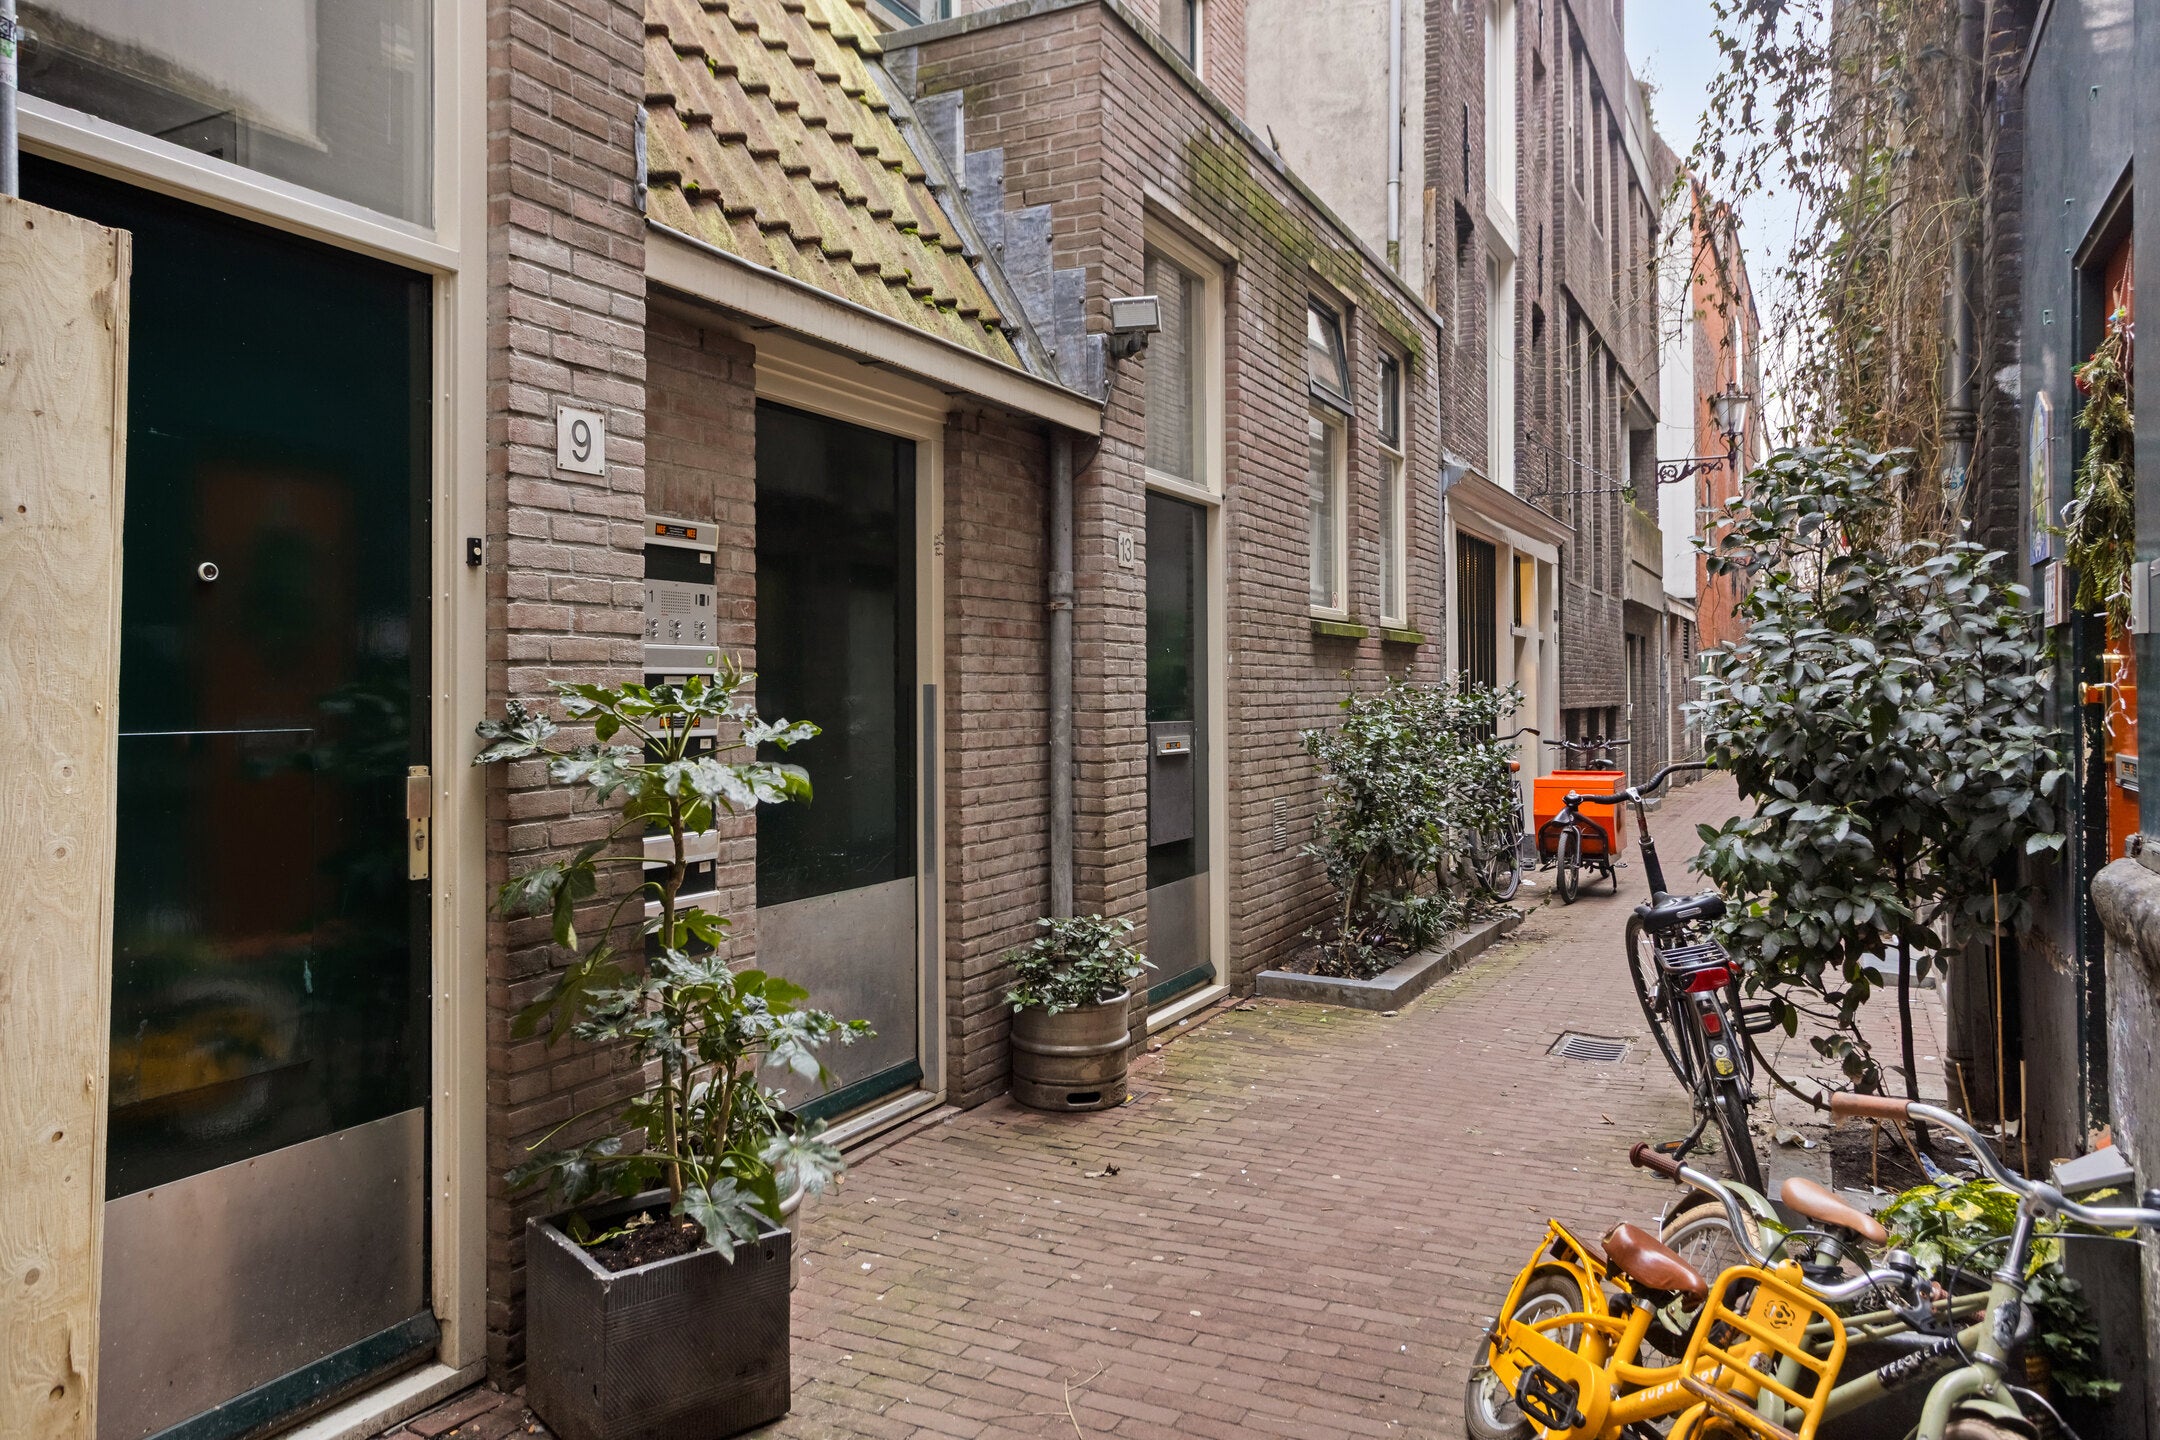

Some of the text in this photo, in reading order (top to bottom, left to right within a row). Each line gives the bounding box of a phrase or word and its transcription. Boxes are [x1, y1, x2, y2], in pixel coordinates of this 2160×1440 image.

[571, 419, 592, 463] 9
[1120, 537, 1132, 562] 13
[645, 618, 651, 626] A
[668, 619, 674, 627] C
[645, 628, 651, 636] B
[668, 630, 674, 638] D
